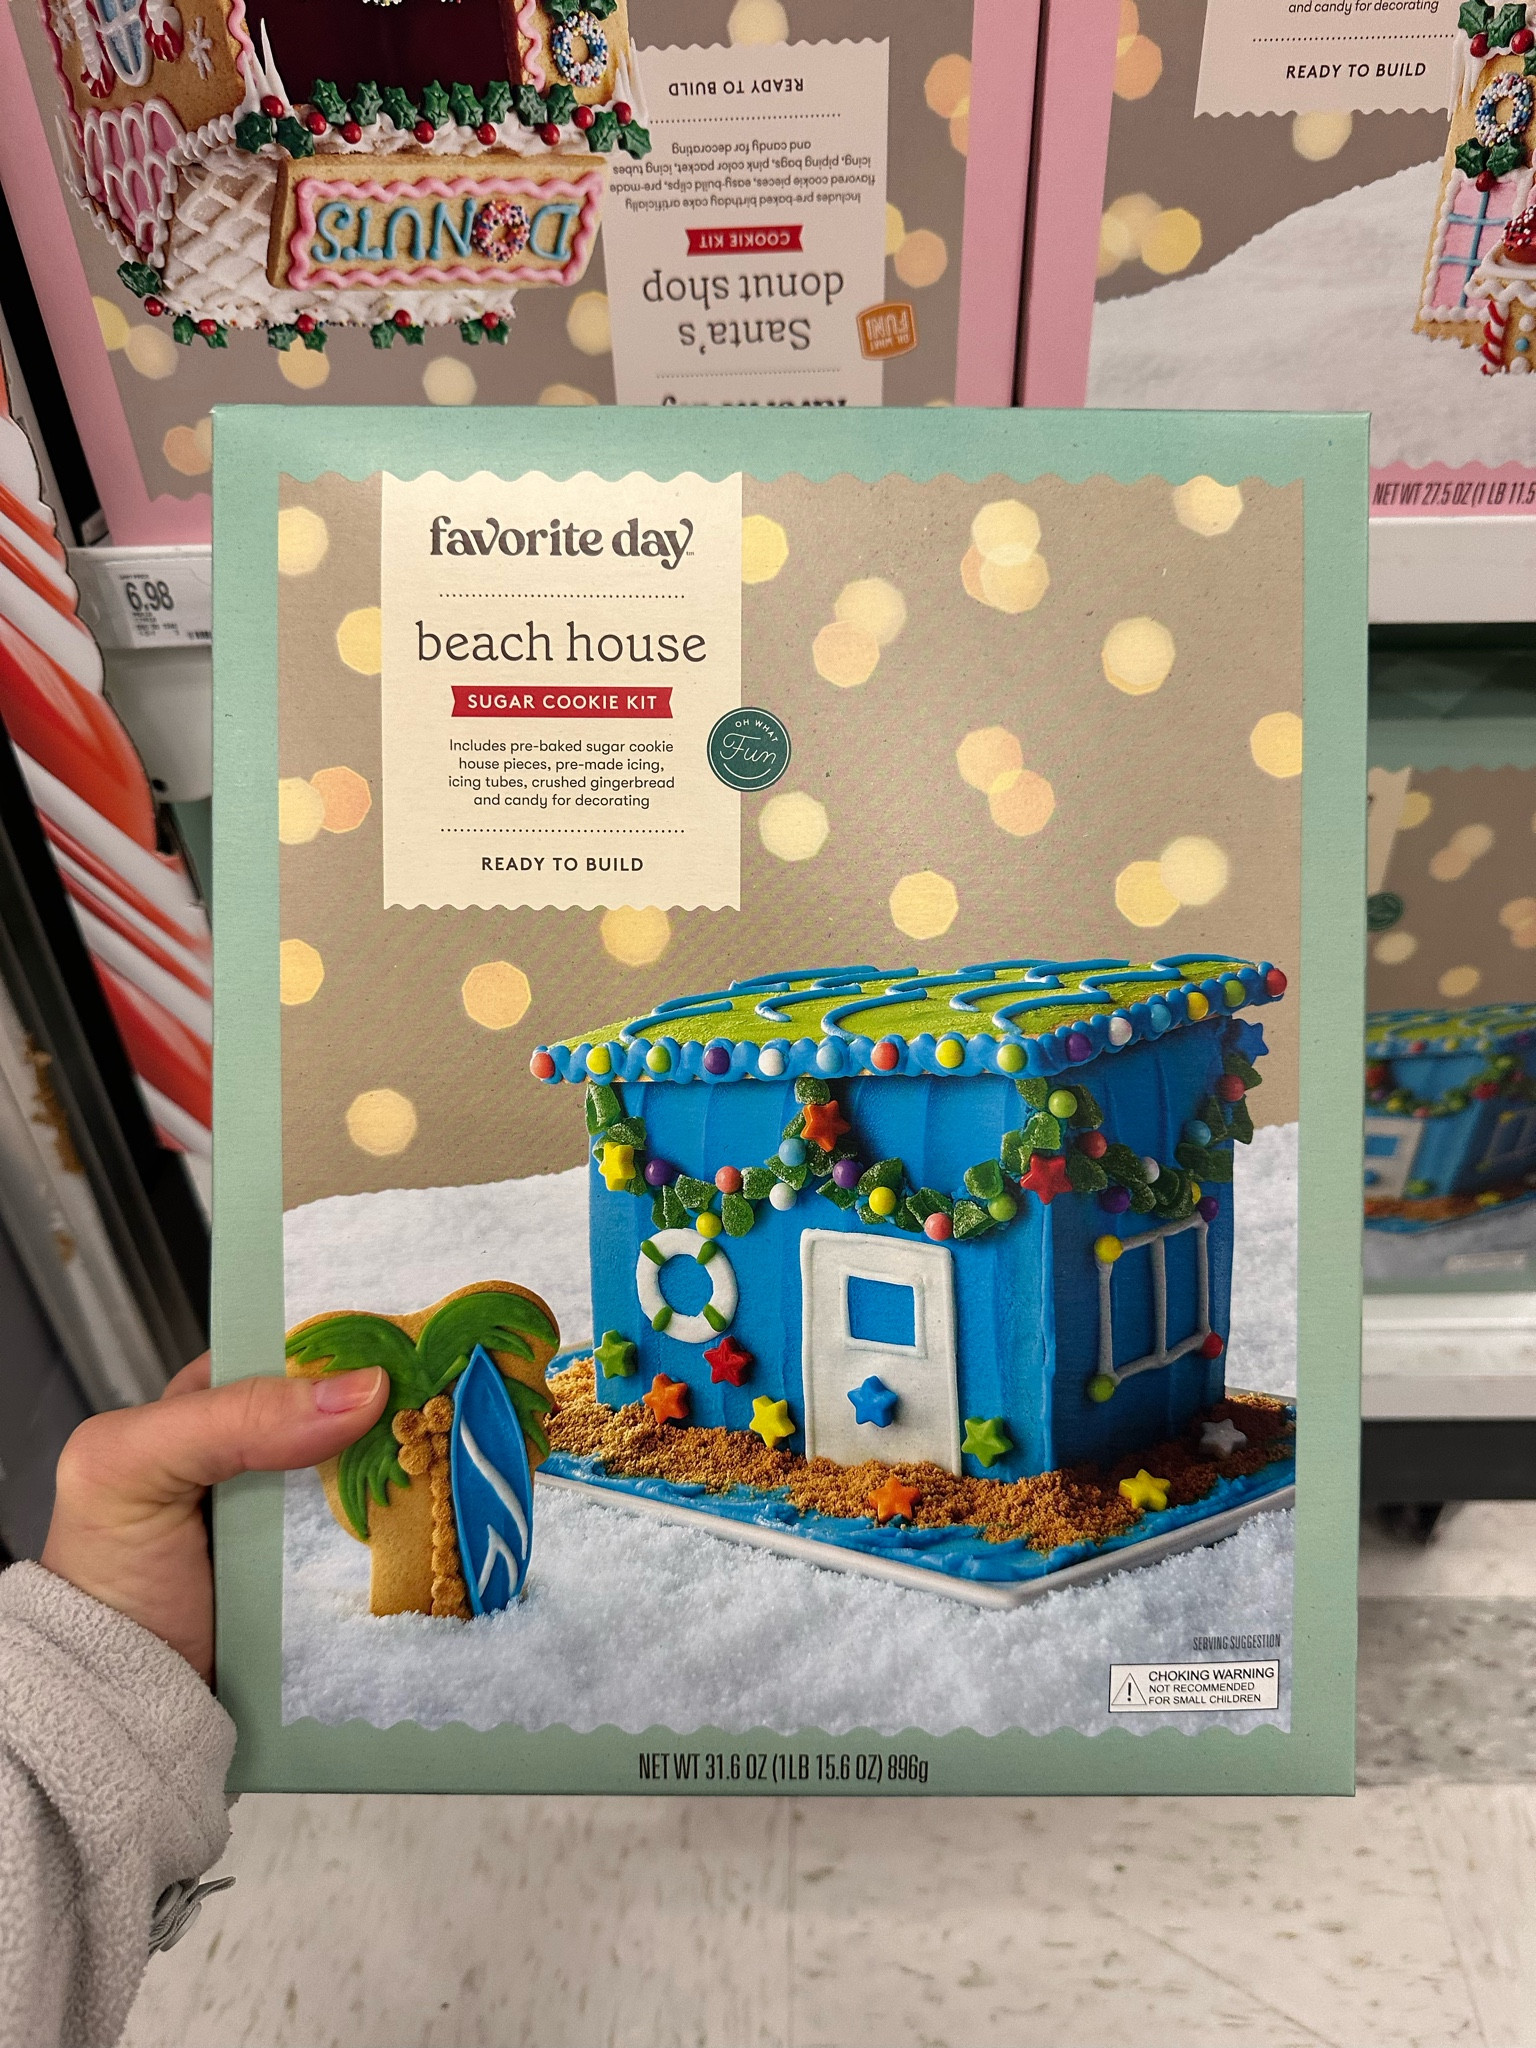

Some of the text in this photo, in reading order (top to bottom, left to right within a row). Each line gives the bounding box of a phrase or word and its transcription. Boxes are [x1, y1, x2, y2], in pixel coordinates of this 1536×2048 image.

[1288, 0, 1439, 15] and candy for decorating
[1286, 62, 1426, 79] READY TO BUILD
[669, 78, 804, 96] READY TO BUILD
[672, 139, 811, 157] and candy for decorating
[613, 154, 871, 177] icing, piping bags, pink color packet, icing tubes
[609, 174, 876, 195] flavored cookie pieces, easy-build clips, pre-made
[625, 198, 680, 212] artificially
[683, 198, 708, 210] cake
[710, 194, 757, 210] birthday
[816, 192, 861, 205] Includes
[699, 231, 790, 249] COOKIE KIT
[643, 269, 844, 310] donut shop
[678, 317, 811, 355] Santa's
[1373, 482, 1399, 505] NET
[1400, 482, 1422, 505] WT
[1421, 482, 1451, 505] 27.5
[1452, 482, 1472, 505] OZ
[430, 515, 604, 557] favorite
[611, 517, 694, 570] day
[125, 580, 174, 611] 6.98
[415, 620, 707, 663] beach house
[468, 694, 657, 710] SUGAR COOKIE KIT
[735, 719, 778, 742] OH WHAT
[450, 739, 674, 755] Includes pre-baked sugar cookie
[720, 733, 777, 765] Fun
[459, 757, 664, 773] house pieces, pre-made icing,
[448, 775, 675, 791] icing tubes, crushed gingerbread
[473, 794, 650, 809] and candy for decorating
[481, 857, 644, 872] READY TO BUILD
[1192, 1633, 1281, 1651] SERVING SUGGESTION
[1148, 1667, 1275, 1682] CHOKING WARNING
[1149, 1682, 1255, 1693] NOT RECOMMENDED
[1149, 1693, 1261, 1705] FOR SMALL CHILDREN
[639, 1753, 670, 1780] NET
[673, 1753, 700, 1780] WT
[705, 1753, 740, 1780] 31.6
[746, 1754, 768, 1780] OZ
[816, 1754, 850, 1780] 15.6
[856, 1754, 883, 1784] OZ)
[887, 1754, 929, 1783] 896g
